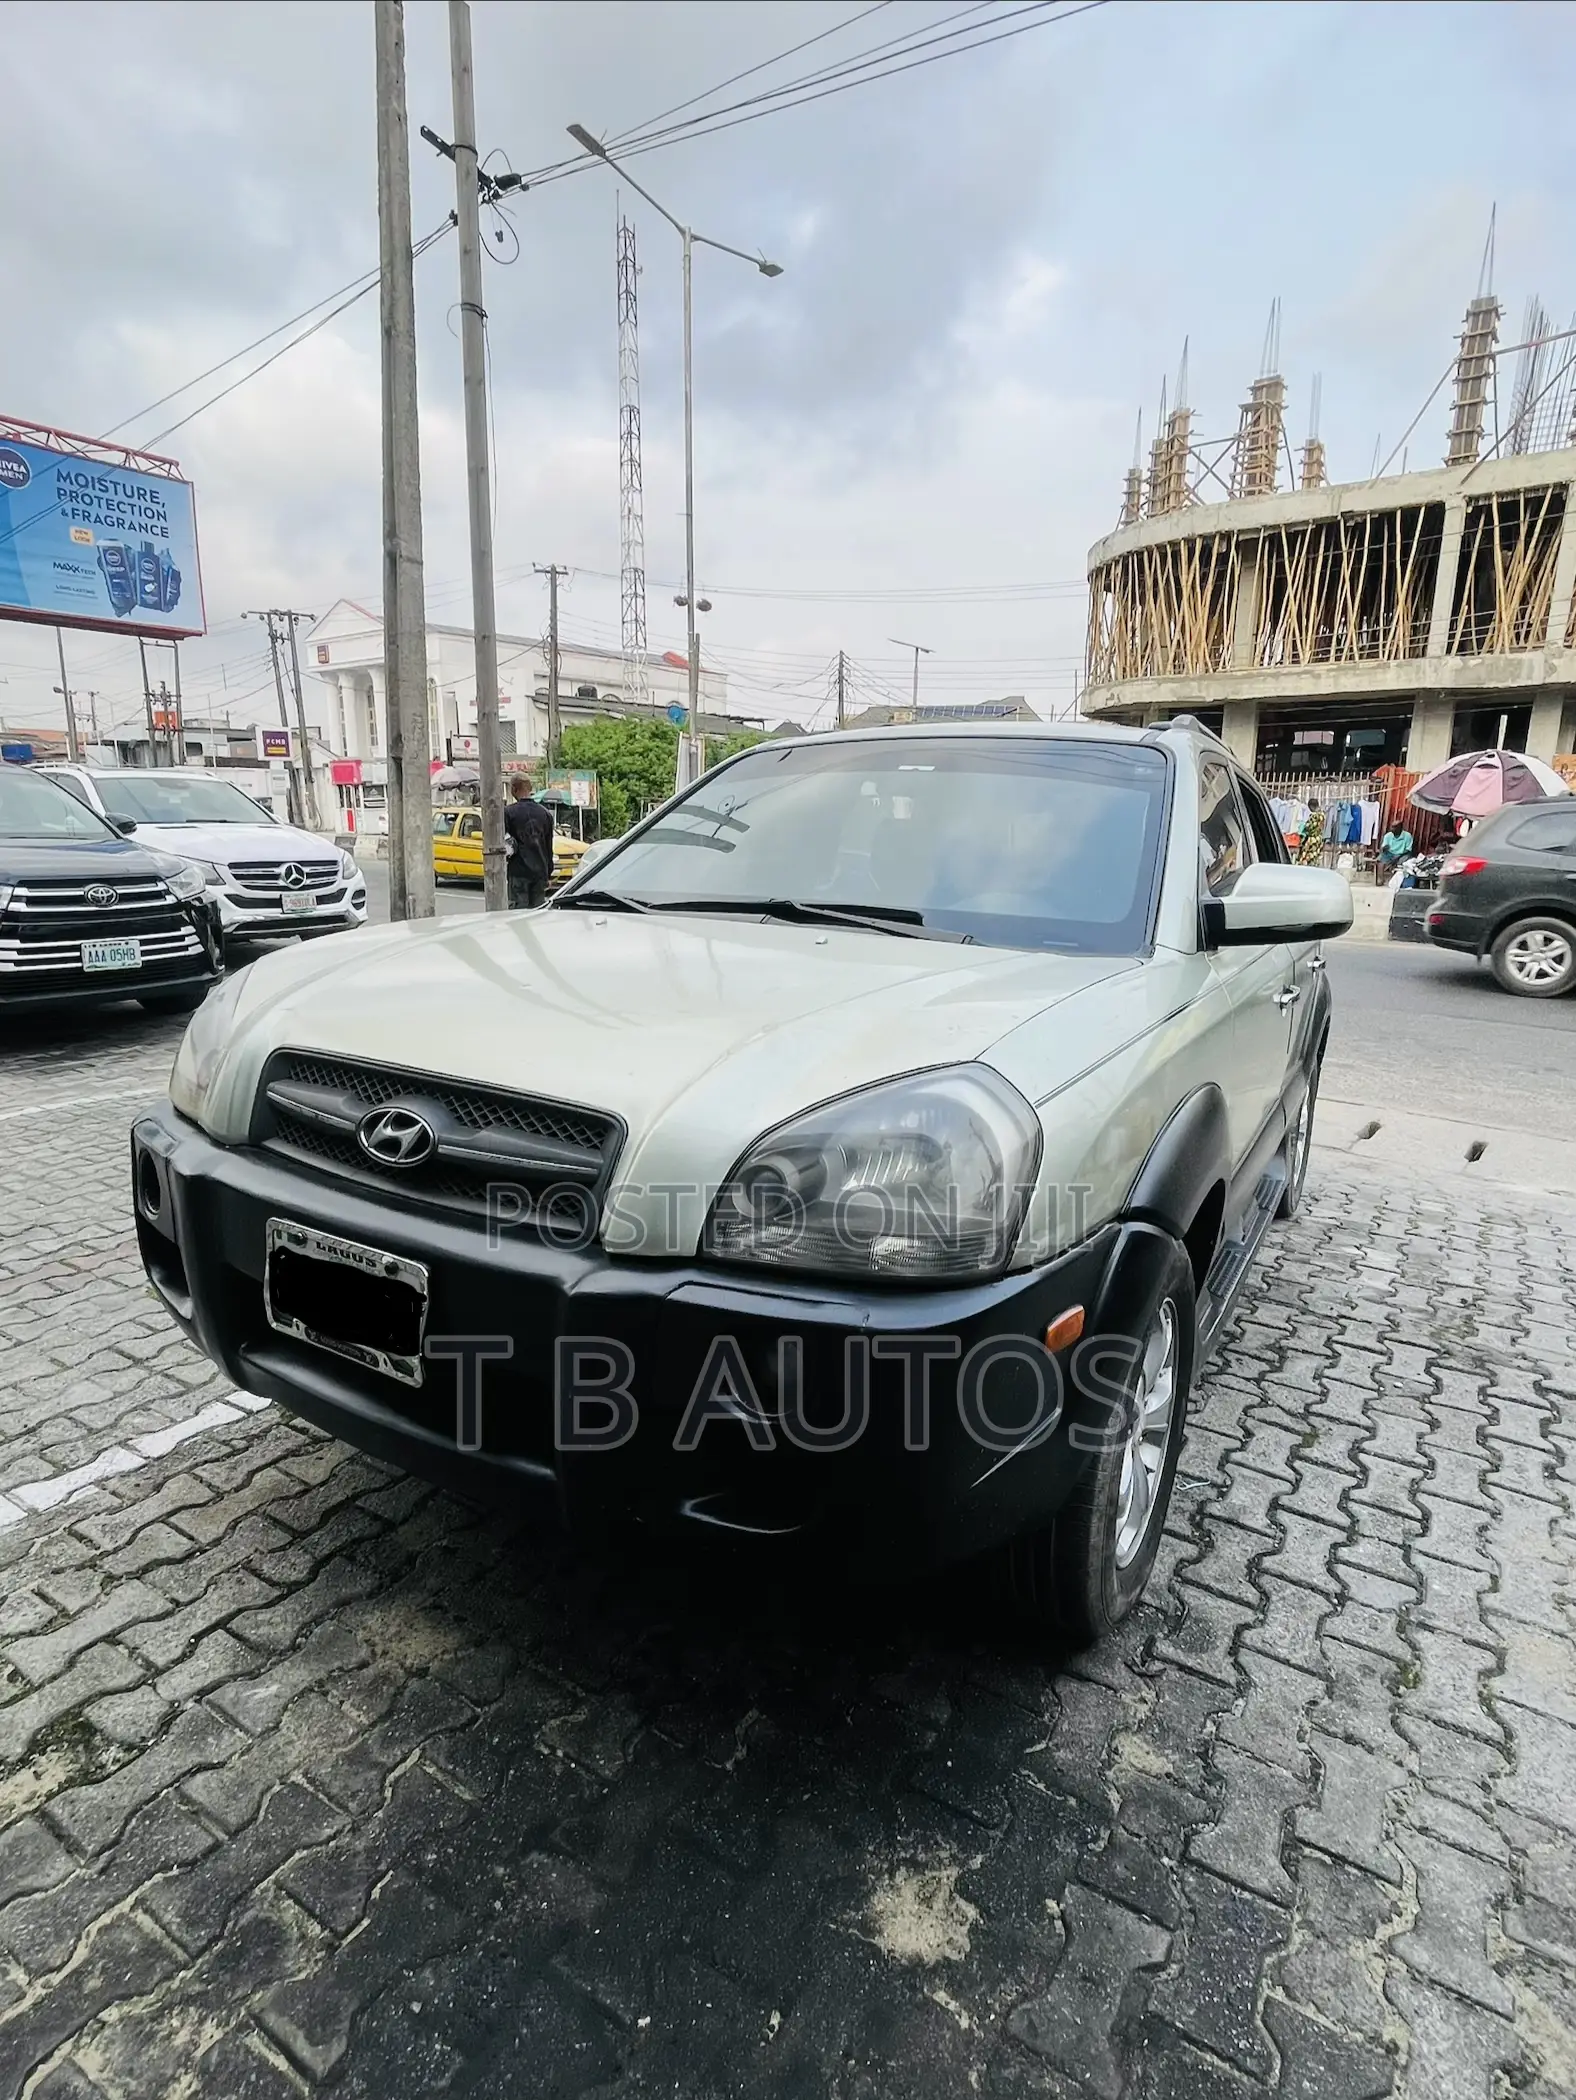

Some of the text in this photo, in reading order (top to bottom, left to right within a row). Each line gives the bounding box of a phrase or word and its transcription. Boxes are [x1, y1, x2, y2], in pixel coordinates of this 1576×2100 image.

[0, 460, 27, 474] IVEA
[56, 468, 165, 508] MOISTURE,
[56, 487, 167, 522] PROTECTION
[61, 507, 169, 538] & FRAGRANCE
